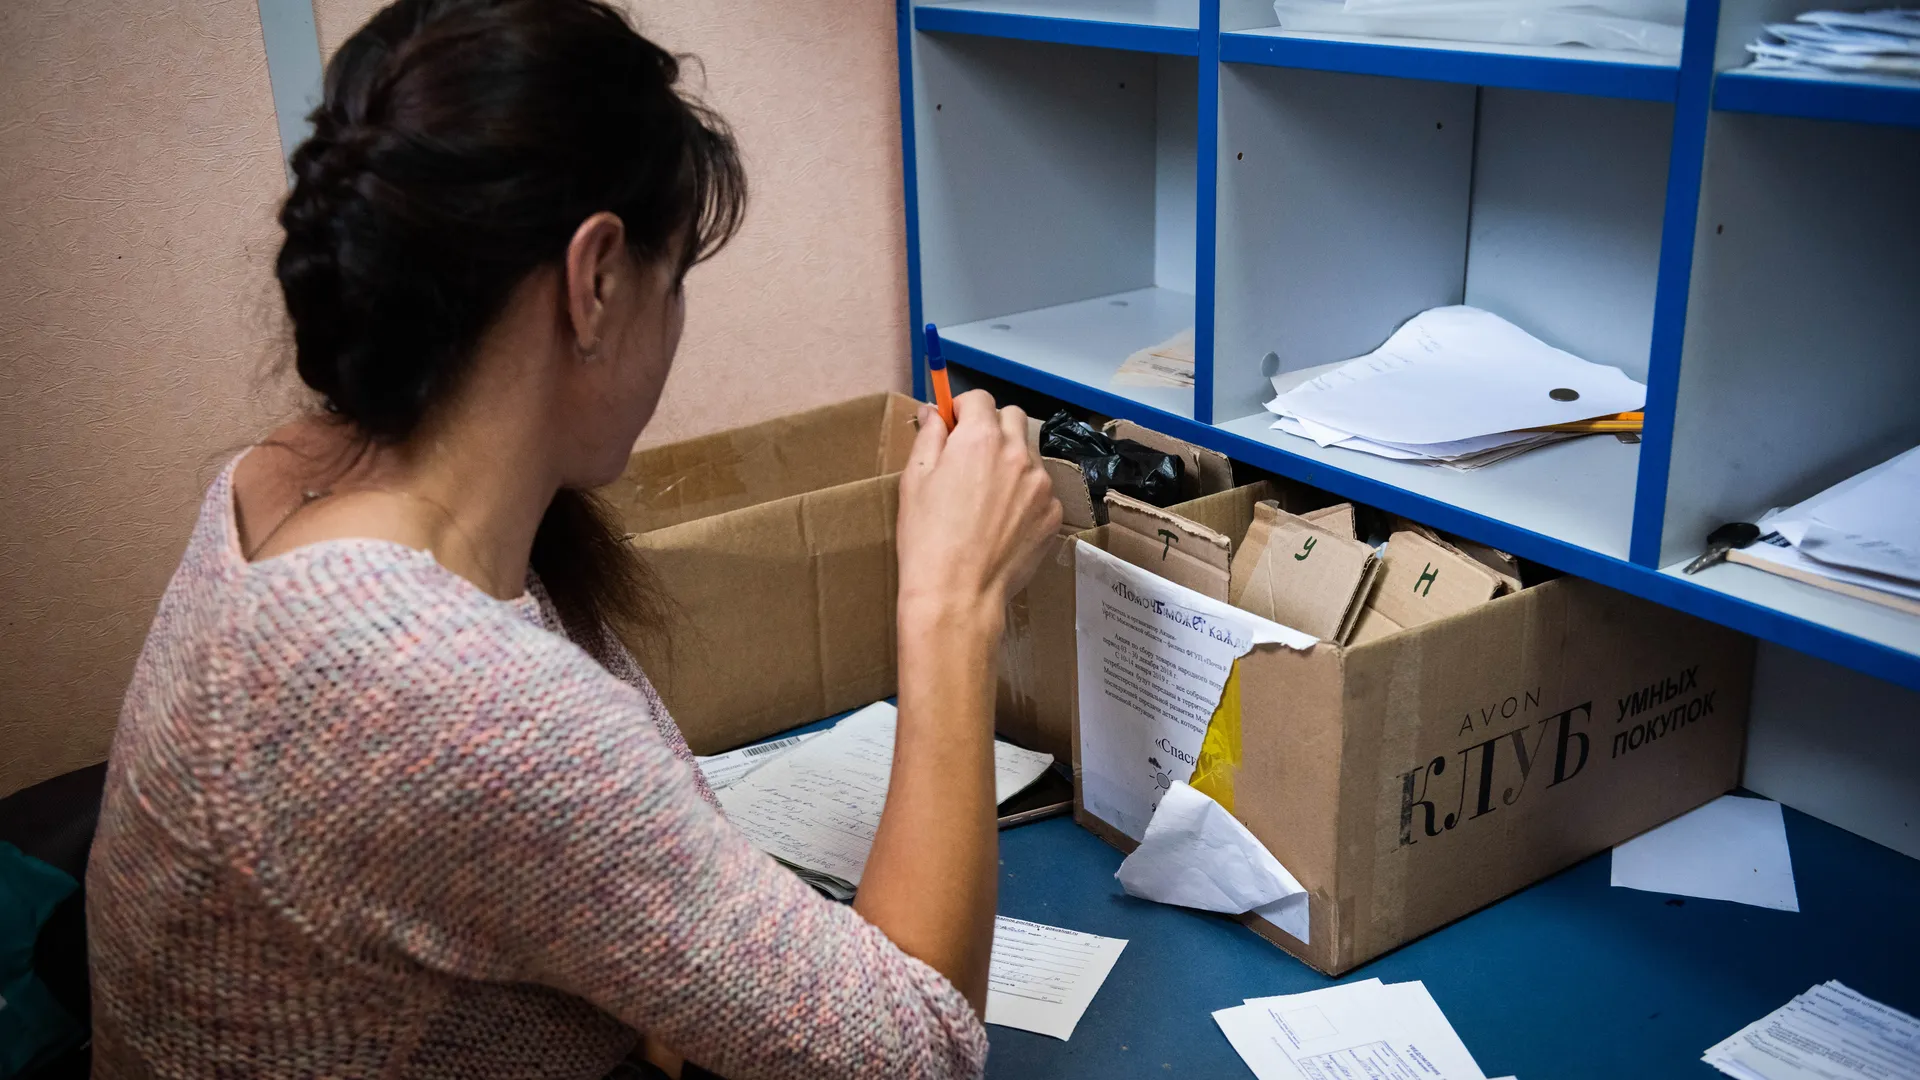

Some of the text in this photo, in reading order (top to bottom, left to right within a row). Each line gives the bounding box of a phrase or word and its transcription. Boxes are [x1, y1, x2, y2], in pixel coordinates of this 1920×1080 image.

[1158, 529, 1178, 560] Т
[1116, 616, 1143, 633] Московской
[1144, 630, 1162, 643] области
[1167, 641, 1184, 654] филиал
[1203, 658, 1222, 670] «Почта
[1131, 617, 1158, 633] организатор
[1103, 637, 1119, 650] период
[1139, 656, 1158, 670] декабря
[1160, 666, 1172, 677] 2018
[1103, 657, 1133, 676] потребления
[1135, 673, 1150, 686] будут
[1151, 683, 1176, 699] переданы
[1114, 633, 1130, 646] Акция
[1139, 645, 1153, 658] сбору
[1155, 655, 1176, 669] товаров
[1177, 666, 1207, 683] народного
[1120, 655, 1133, 666] 10-14
[1134, 663, 1151, 675] января
[1152, 672, 1164, 682] 2019
[1175, 685, 1184, 693] все
[1103, 667, 1138, 689] Министерства
[1169, 703, 1194, 719] развития
[1104, 679, 1137, 700] последующей
[1138, 698, 1161, 714] передачи
[1162, 710, 1179, 723] детям,
[1105, 690, 1155, 720] жизненной ситуации.
[1458, 687, 1541, 737] AVON
[1616, 665, 1699, 723] УМНЫХ
[1612, 690, 1716, 759] ПОКУПОК
[1392, 701, 1592, 852] КЛУБ
